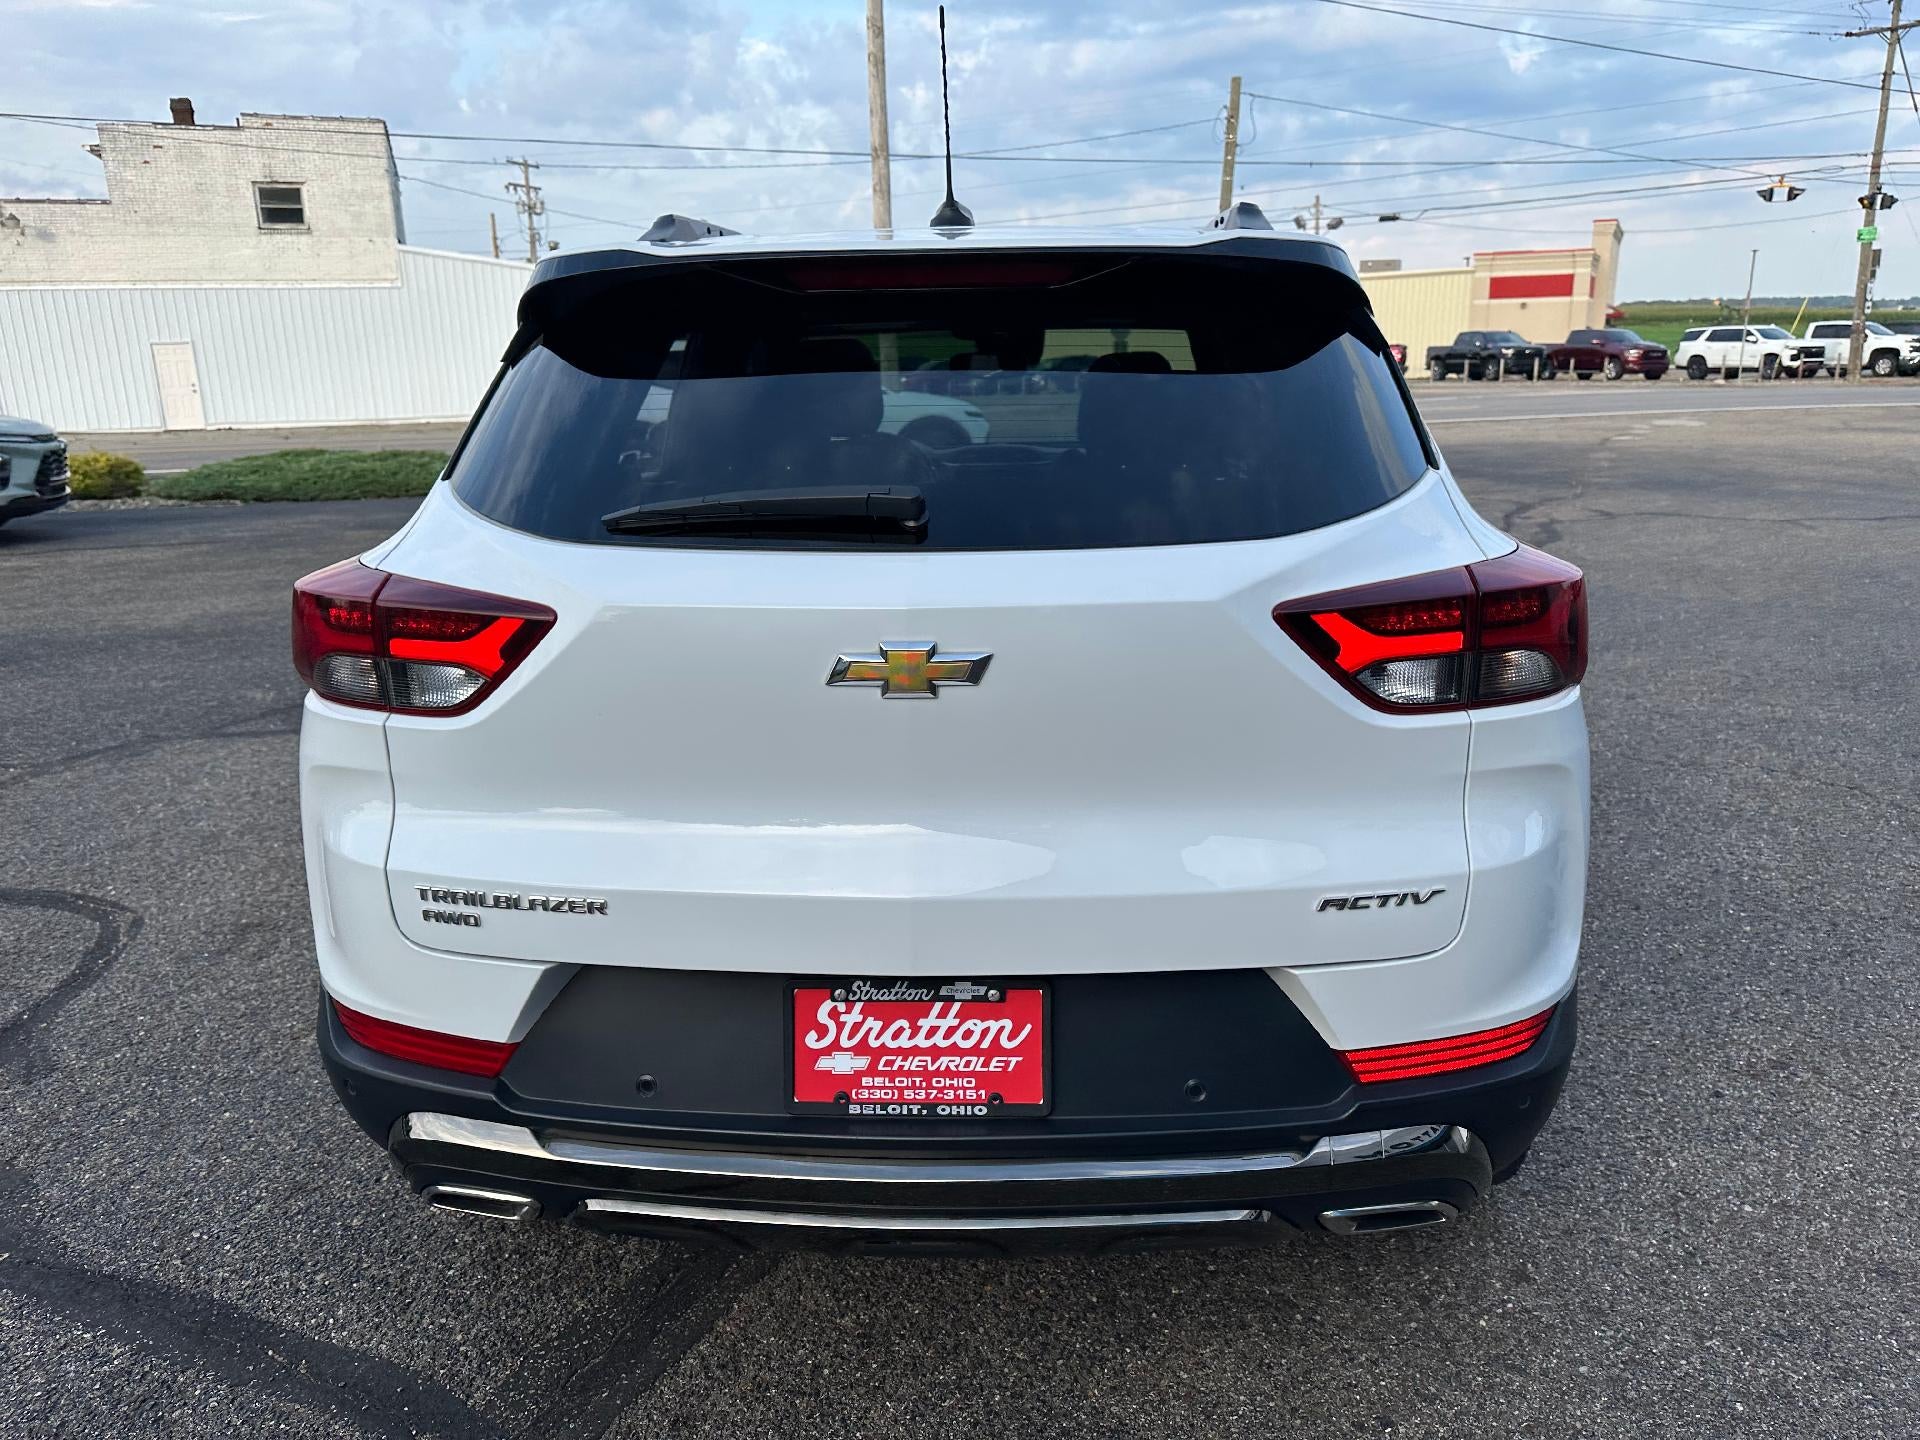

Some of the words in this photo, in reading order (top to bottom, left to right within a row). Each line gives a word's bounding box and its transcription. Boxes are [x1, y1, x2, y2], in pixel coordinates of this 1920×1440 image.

[414, 884, 608, 915] TRAILBLAZER
[1316, 886, 1447, 912] ACTIV
[422, 908, 482, 928] AWD
[847, 980, 934, 1001] Stratton
[946, 986, 981, 995] Chevrolet
[804, 999, 1033, 1049] Stratton
[877, 1056, 1024, 1072] CHEVROLET
[861, 1077, 926, 1088] BELOIT,
[932, 1077, 976, 1088] OHIO
[851, 1089, 899, 1100] (330)
[903, 1089, 987, 1100] 537-3151
[848, 1104, 928, 1116] BELOIT,
[936, 1105, 988, 1116] OHIO
